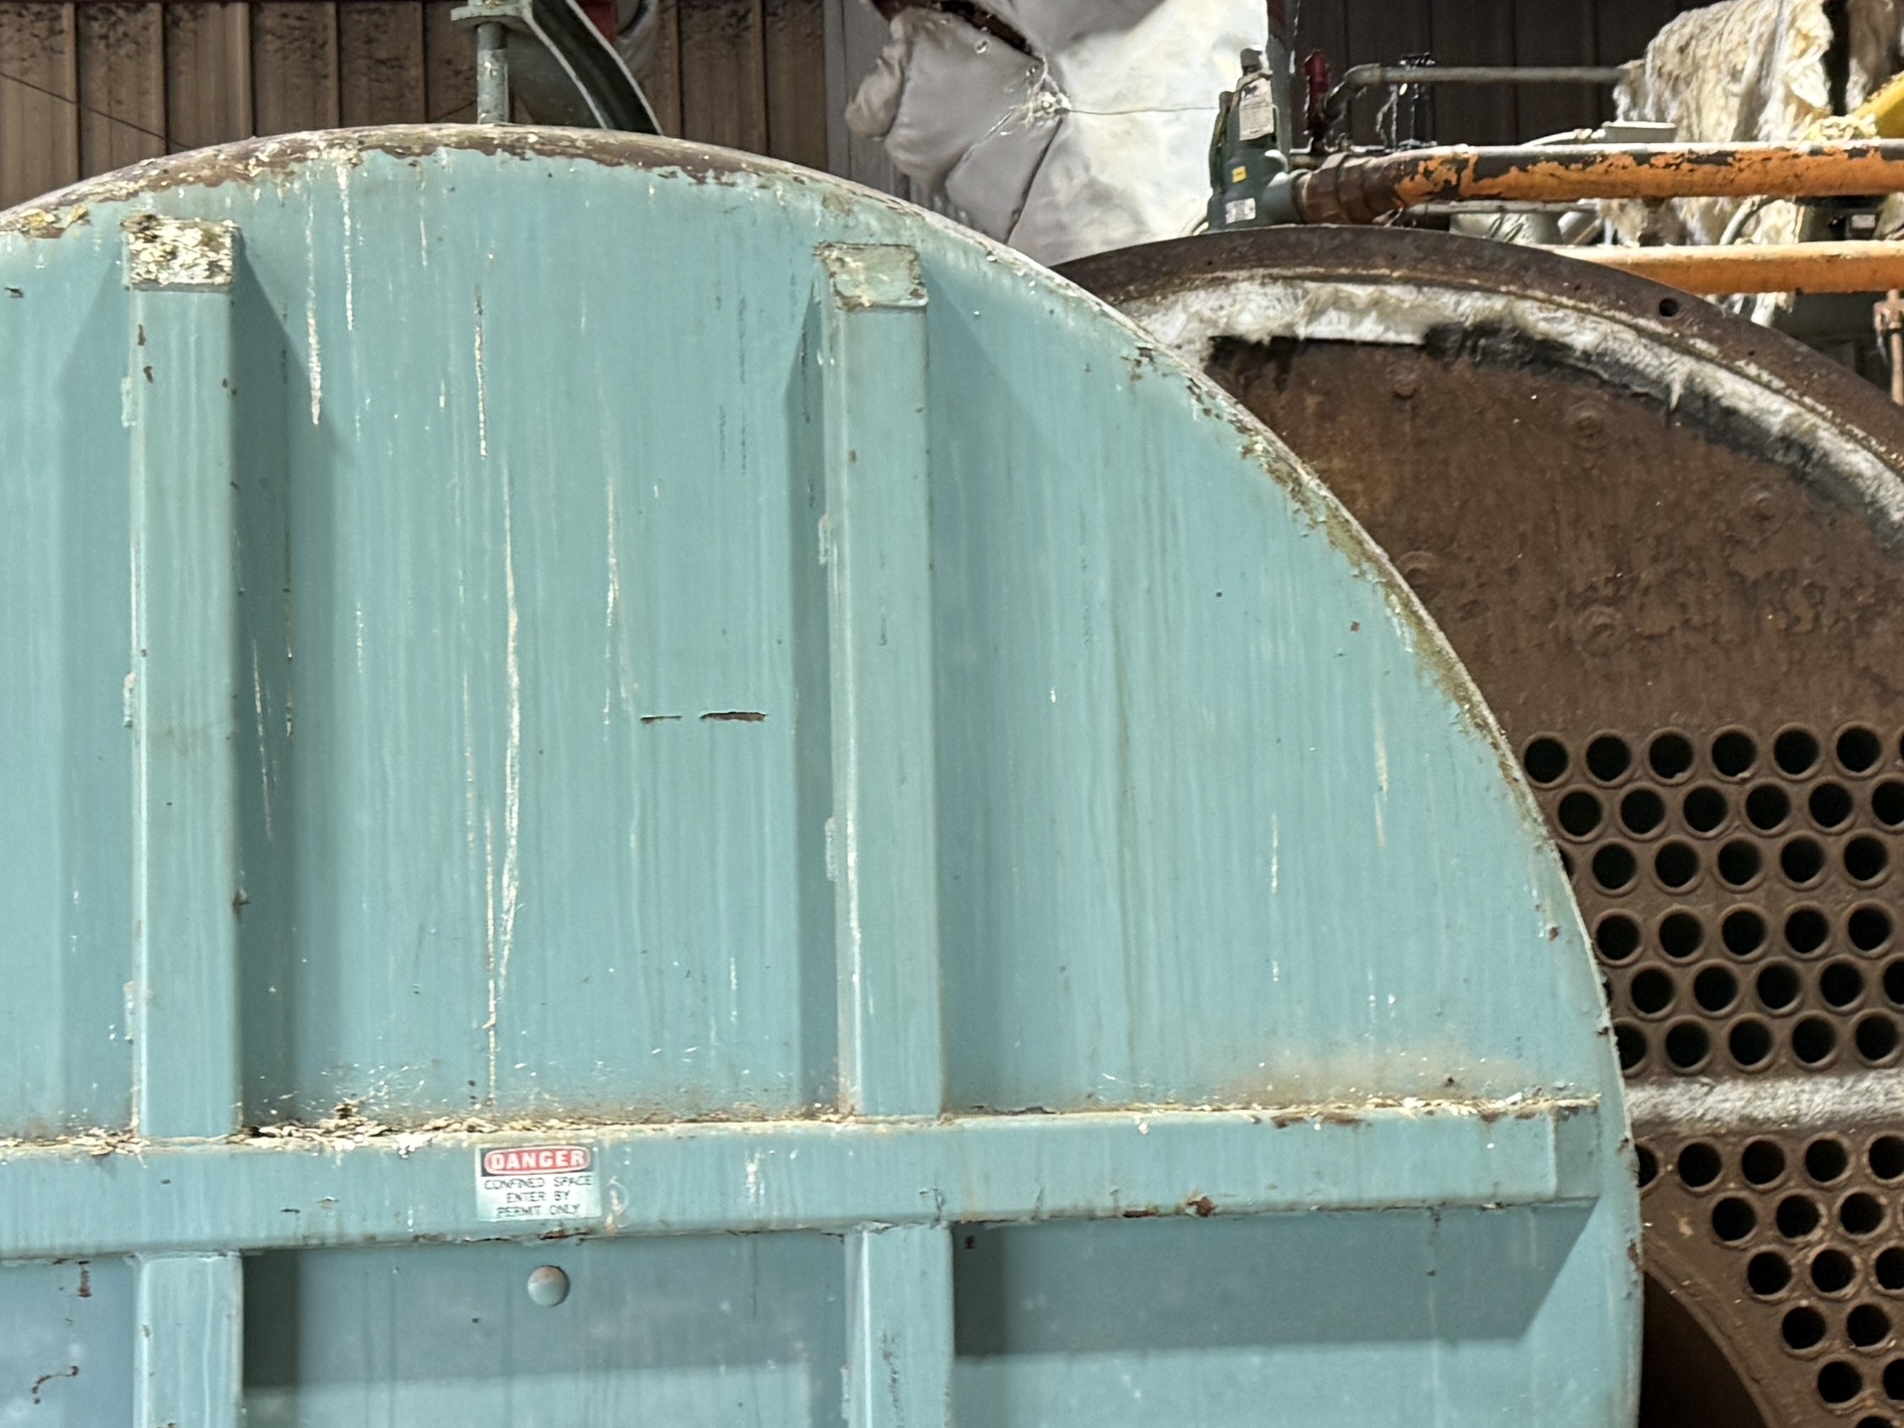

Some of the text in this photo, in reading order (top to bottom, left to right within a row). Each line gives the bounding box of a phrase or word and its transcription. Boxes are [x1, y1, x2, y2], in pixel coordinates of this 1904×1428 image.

[490, 1151, 585, 1170] DANGER
[484, 1175, 594, 1190] CONFINED SPACE
[506, 1190, 571, 1204] ENTER BY
[497, 1203, 581, 1218] PERMIT ONLY
